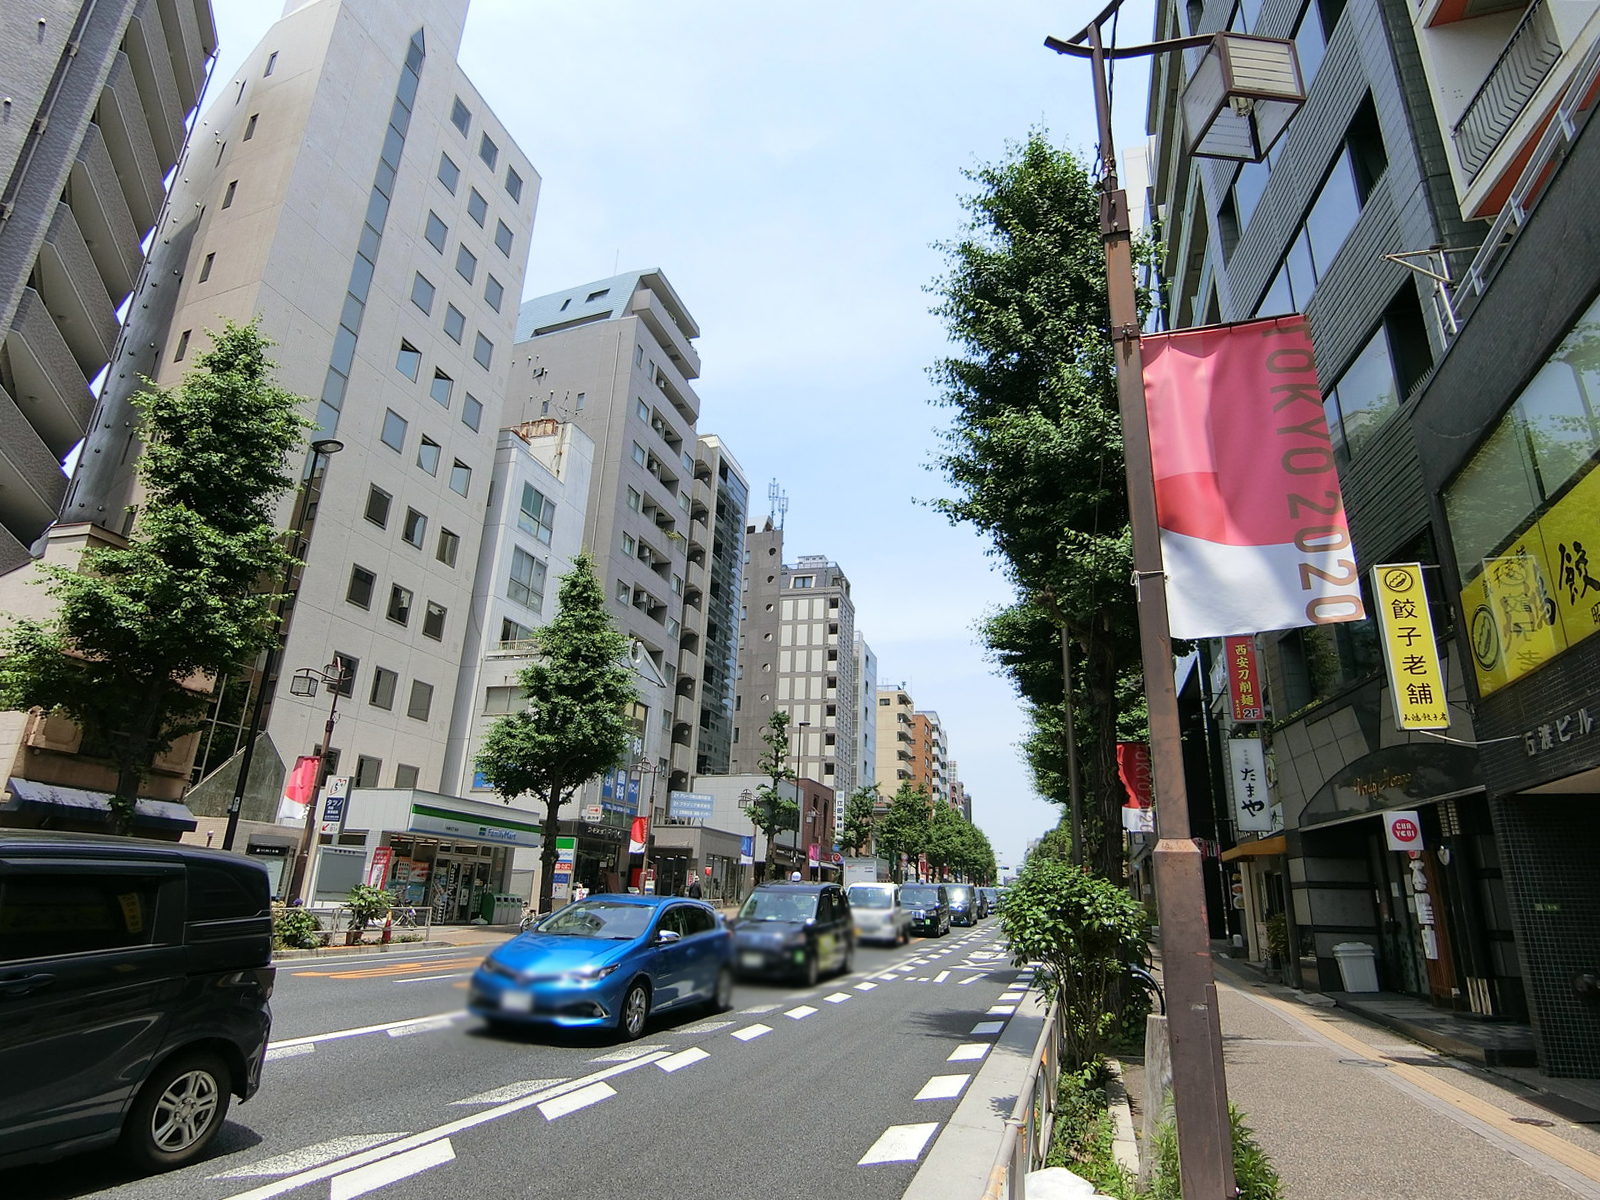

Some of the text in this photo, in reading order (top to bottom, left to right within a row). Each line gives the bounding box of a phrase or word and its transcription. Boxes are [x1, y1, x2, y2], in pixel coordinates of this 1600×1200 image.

[1261, 318, 1367, 624] TOKYO 2020
[1235, 644, 1254, 706] 西安刀削麺
[1391, 598, 1433, 705] 餃子老舗
[1243, 708, 1259, 718] 2F
[1240, 768, 1265, 817] たまや
[487, 828, 517, 840] FamilyMart
